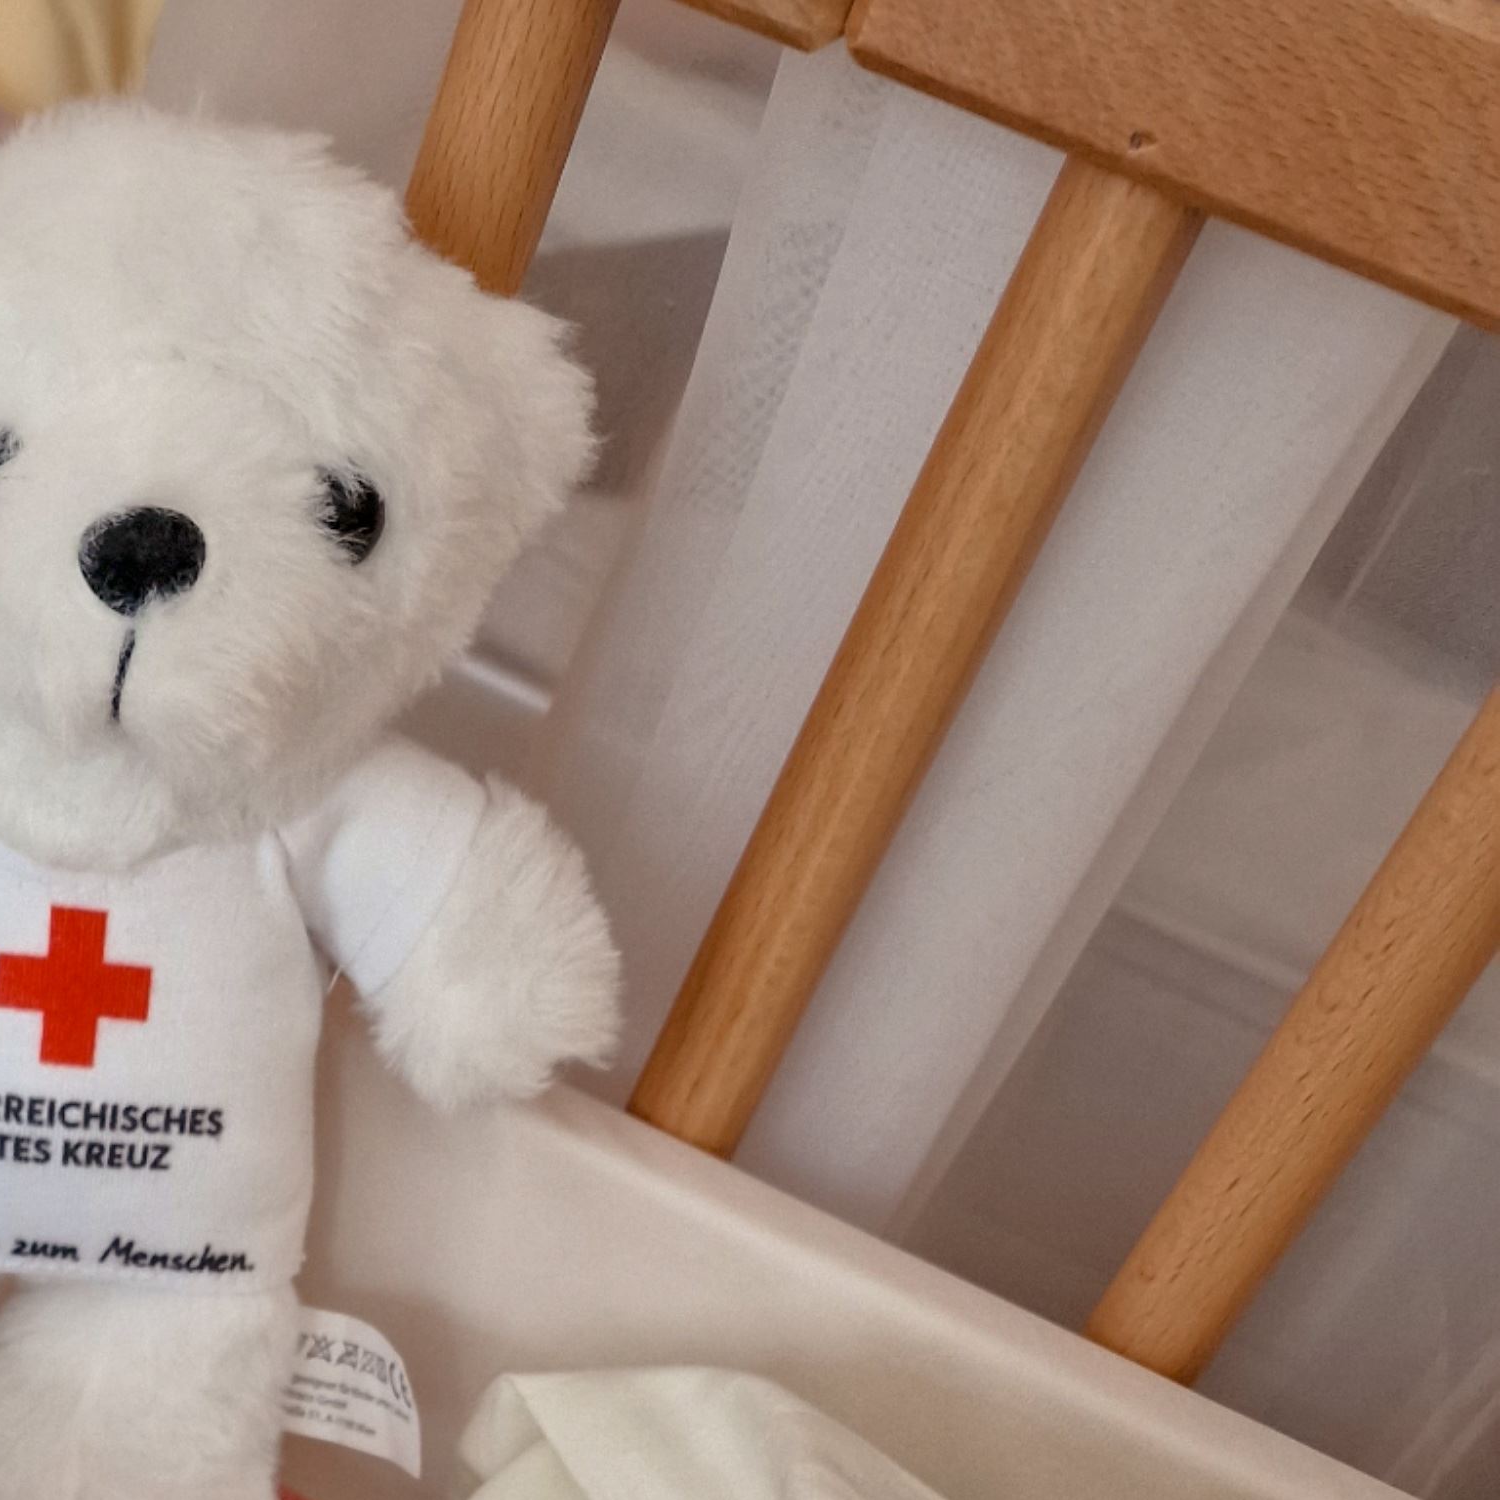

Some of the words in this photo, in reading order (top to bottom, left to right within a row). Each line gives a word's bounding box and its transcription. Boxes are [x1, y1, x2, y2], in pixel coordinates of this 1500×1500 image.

[61, 1140, 170, 1171] KREUZ
[11, 1237, 80, 1263] zum
[99, 1235, 255, 1274] Menschen.
